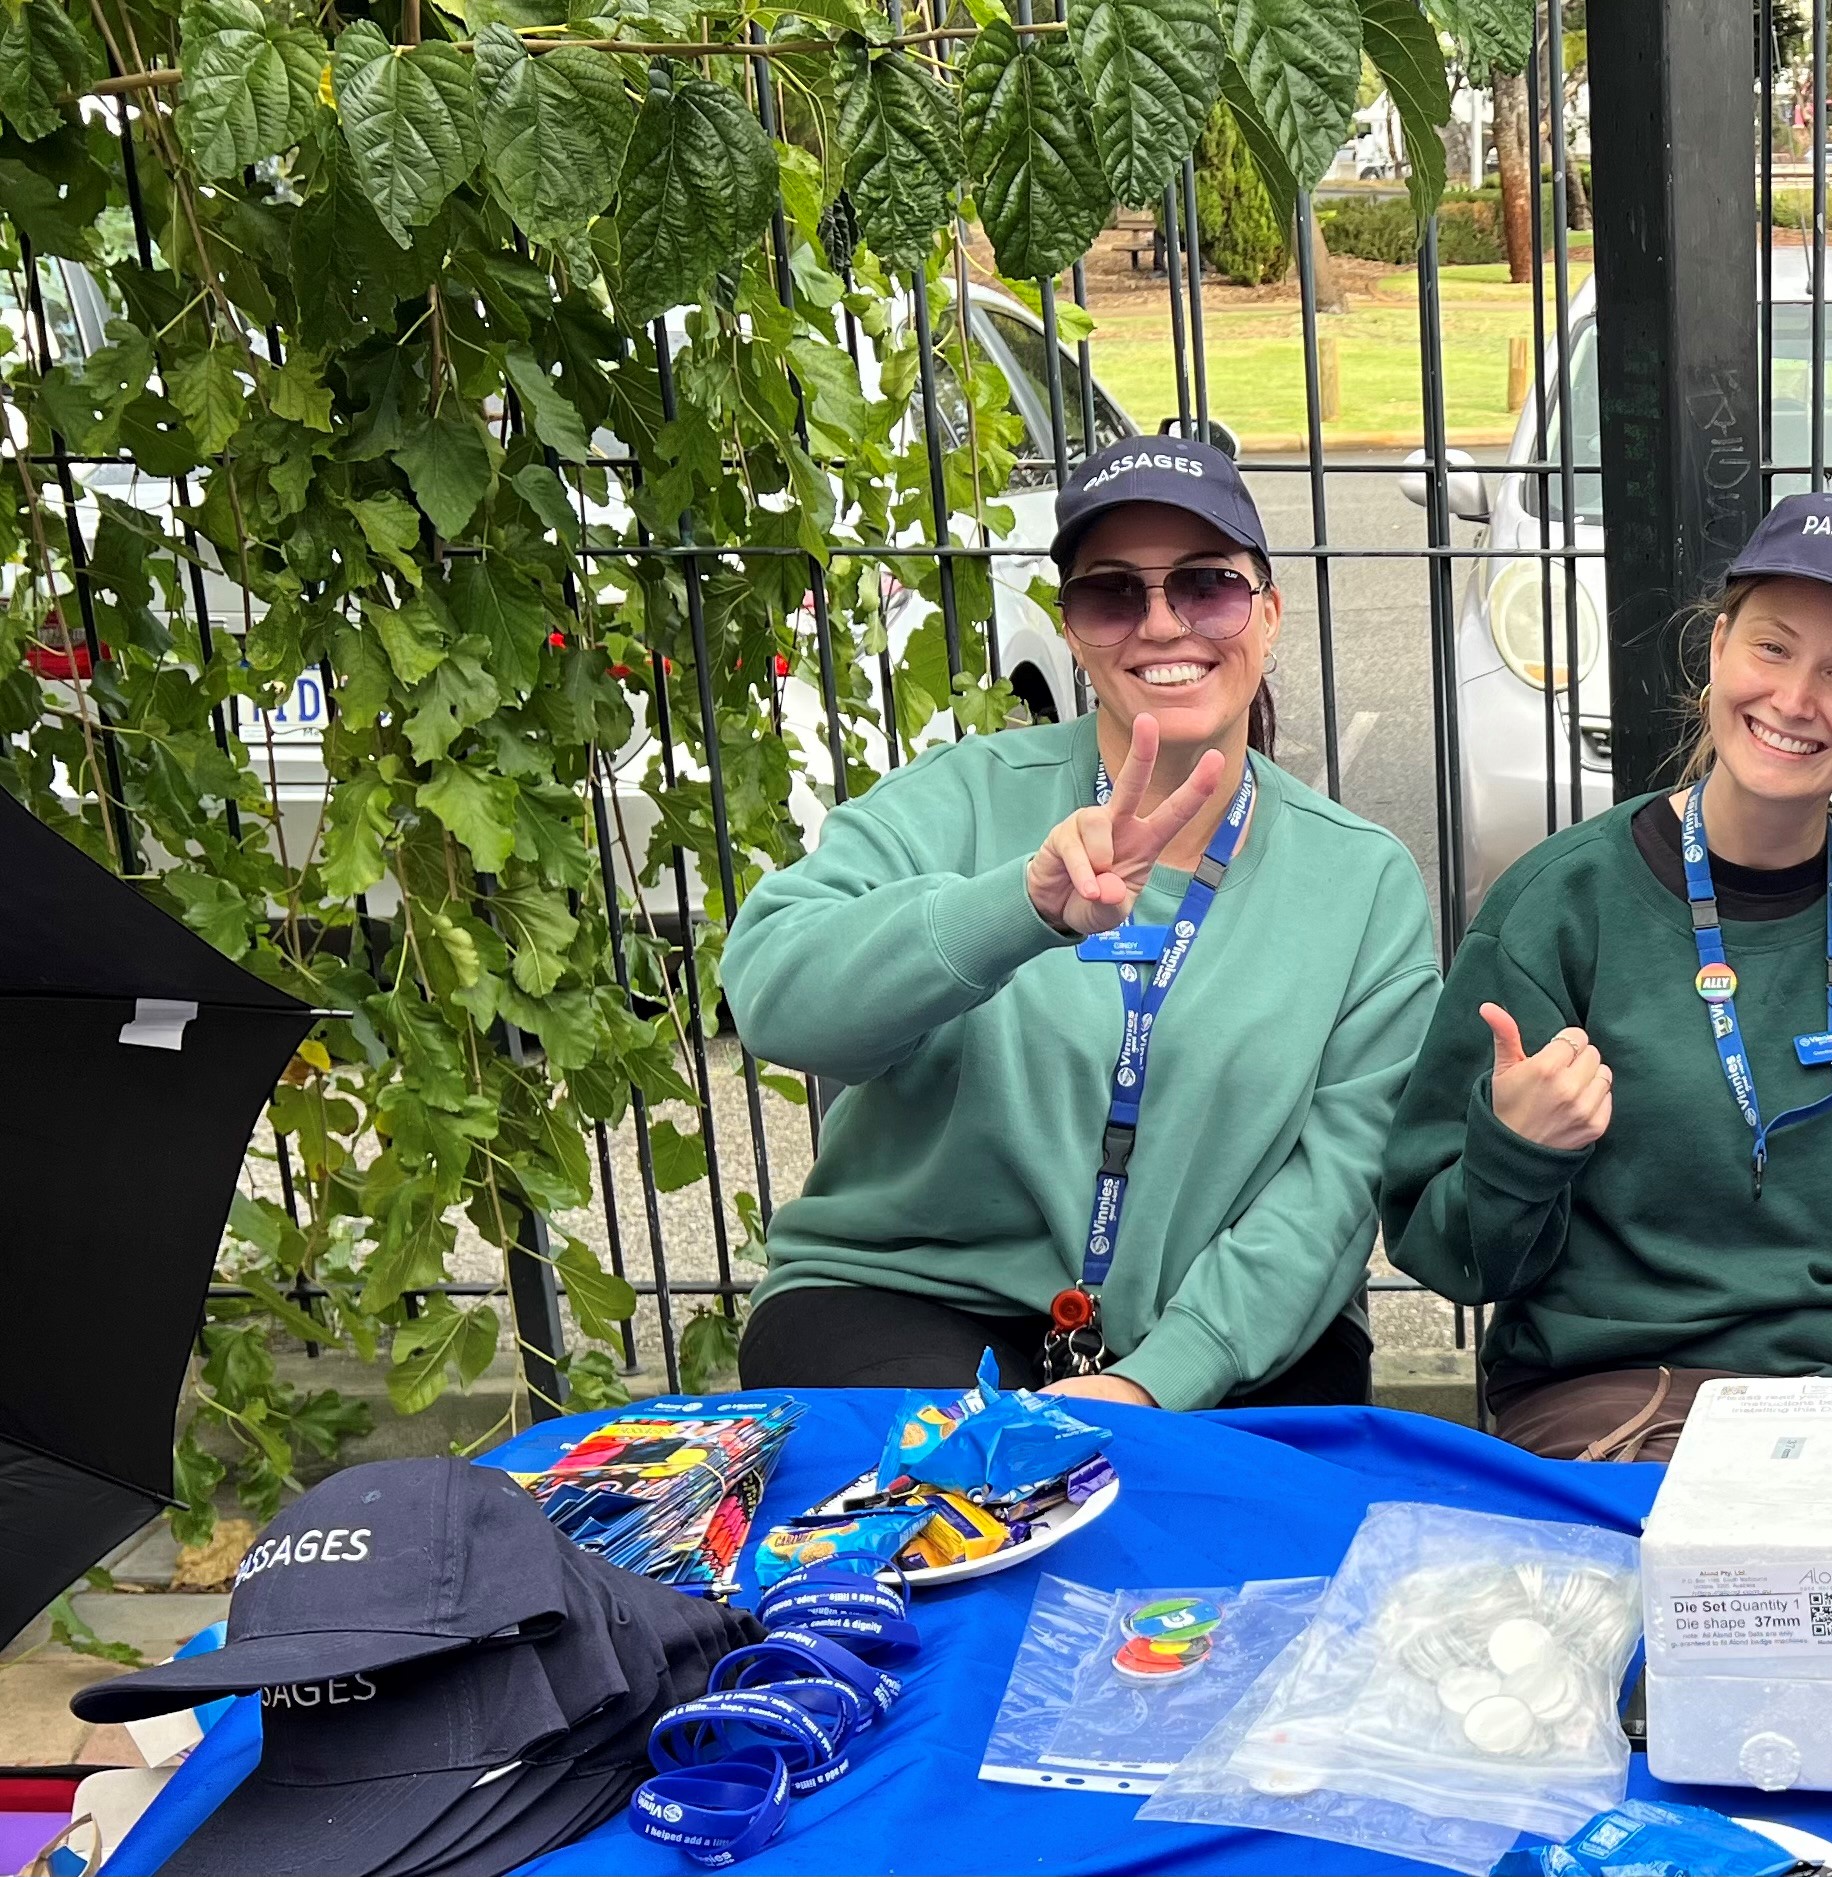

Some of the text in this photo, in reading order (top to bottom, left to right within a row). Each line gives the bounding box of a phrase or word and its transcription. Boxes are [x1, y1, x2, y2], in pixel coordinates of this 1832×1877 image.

[1083, 452, 1204, 492] PASSAGES
[1229, 775, 1253, 828] Vinnies
[1683, 794, 1698, 847] Vinnies
[1158, 939, 1190, 988] Vinnies
[1702, 977, 1730, 989] ALLY
[1119, 1010, 1135, 1066] Vinnies
[1725, 1054, 1750, 1111] Vinnies
[1091, 1178, 1114, 1236] Vinnies
[1674, 1601, 1698, 1614] Die
[1702, 1600, 1727, 1613] Set
[1730, 1599, 1788, 1613] Quantity
[1676, 1615, 1801, 1631] Die shape 37mm
[851, 1619, 883, 1635] dignity
[260, 1672, 377, 1709] SAGES
[650, 1825, 683, 1842] helped
[684, 1836, 702, 1846] add
